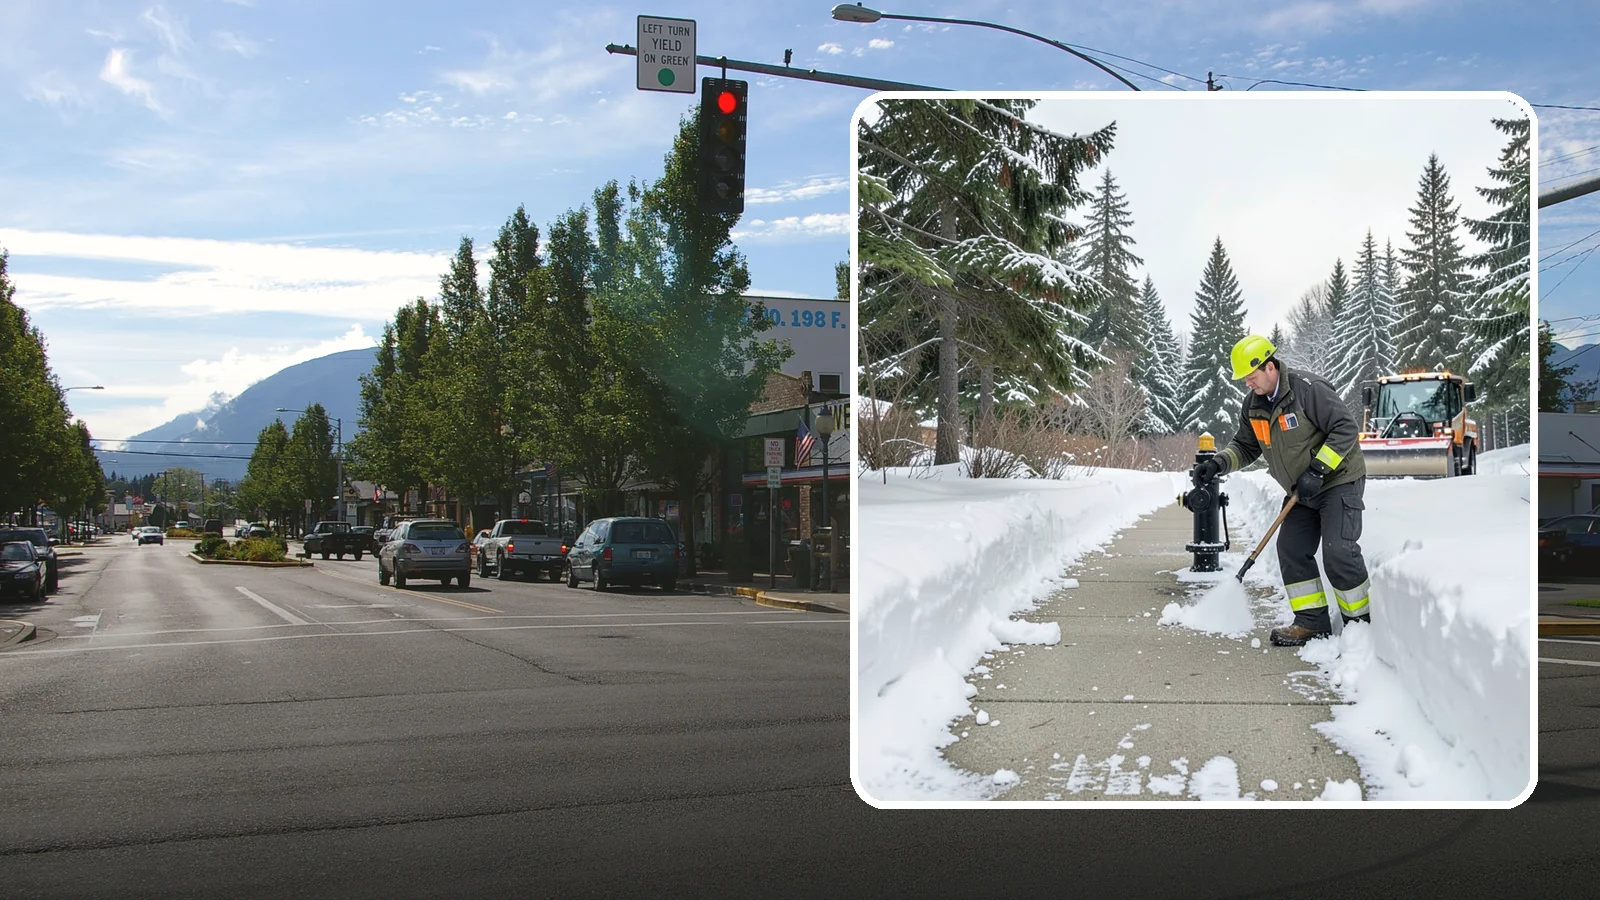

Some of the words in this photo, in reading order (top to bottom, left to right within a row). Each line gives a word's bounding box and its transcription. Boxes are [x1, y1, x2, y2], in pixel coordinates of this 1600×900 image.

[643, 24, 663, 34] LEFT
[668, 26, 690, 36] TURN
[652, 38, 682, 52] YIELD
[644, 54, 656, 63] ON
[661, 55, 689, 66] GREEN
[791, 309, 826, 328] 198
[831, 311, 847, 329] F.
